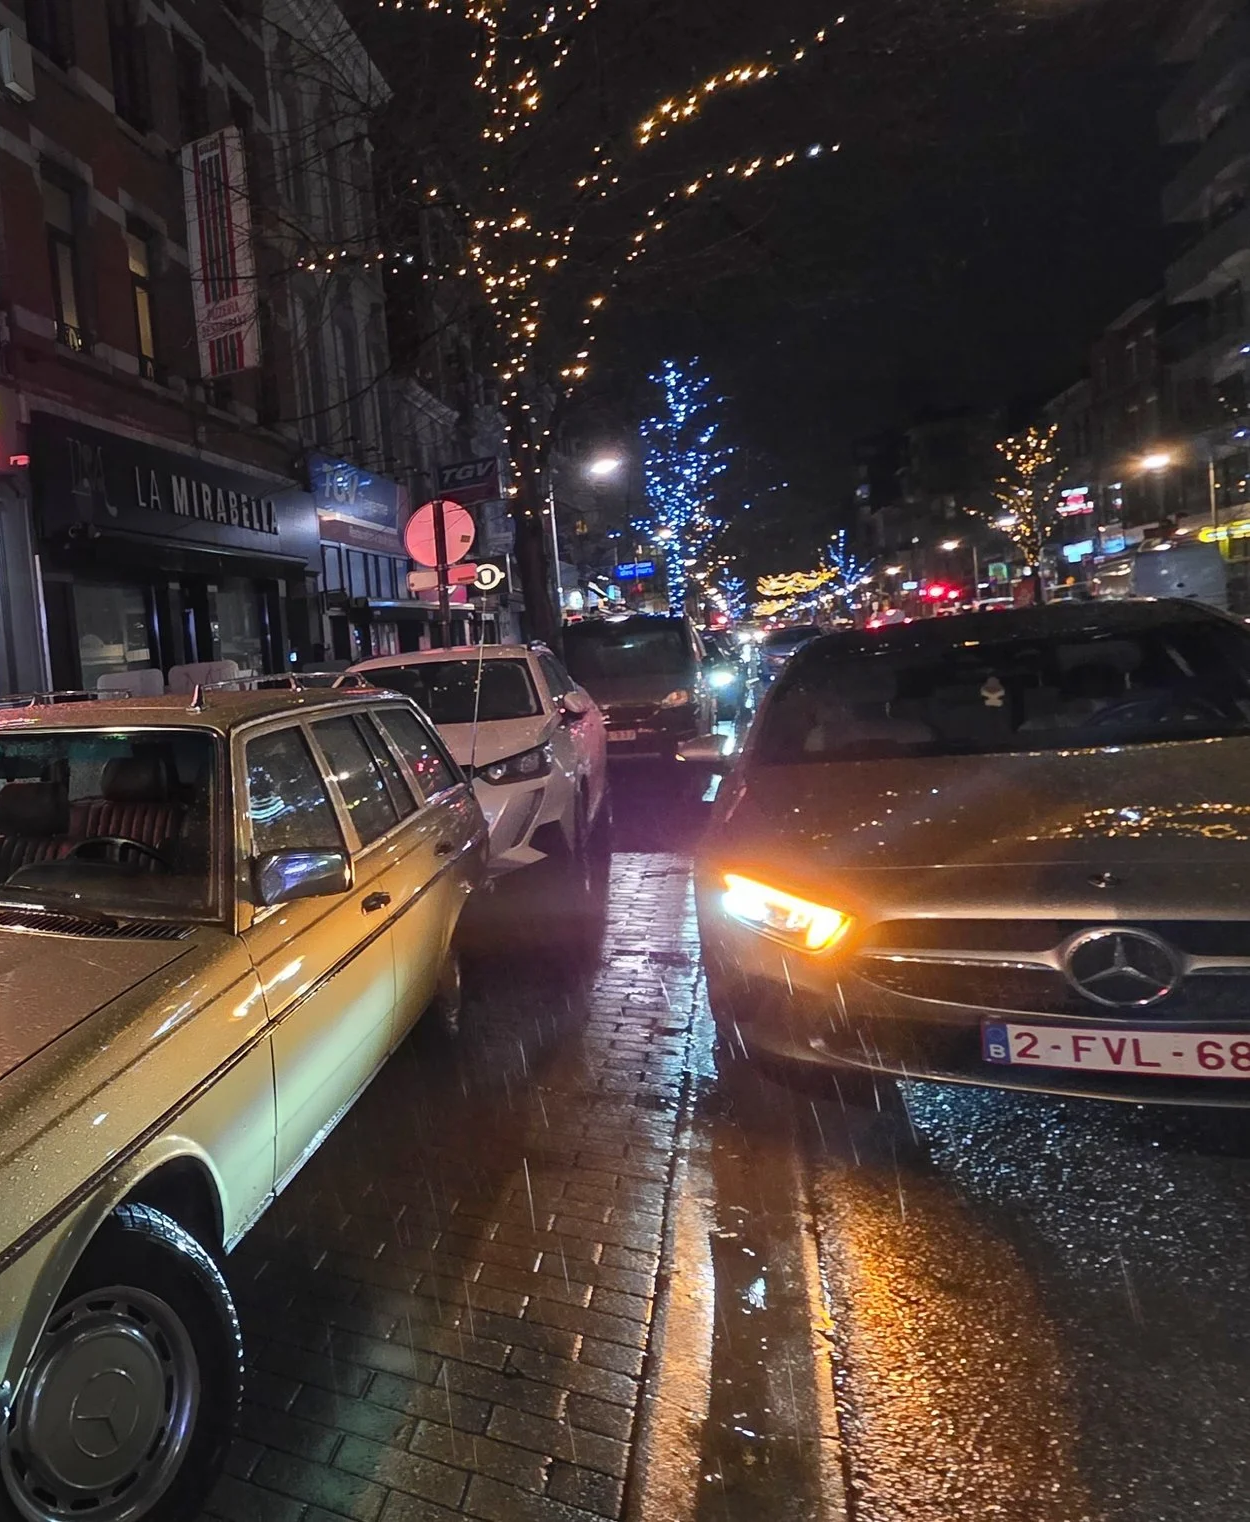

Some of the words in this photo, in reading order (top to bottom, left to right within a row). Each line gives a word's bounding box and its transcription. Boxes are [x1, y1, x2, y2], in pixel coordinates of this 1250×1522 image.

[442, 461, 496, 483] TGV
[135, 466, 162, 511] LA
[171, 474, 280, 535] MIRABELLA
[989, 1043, 1006, 1058] B
